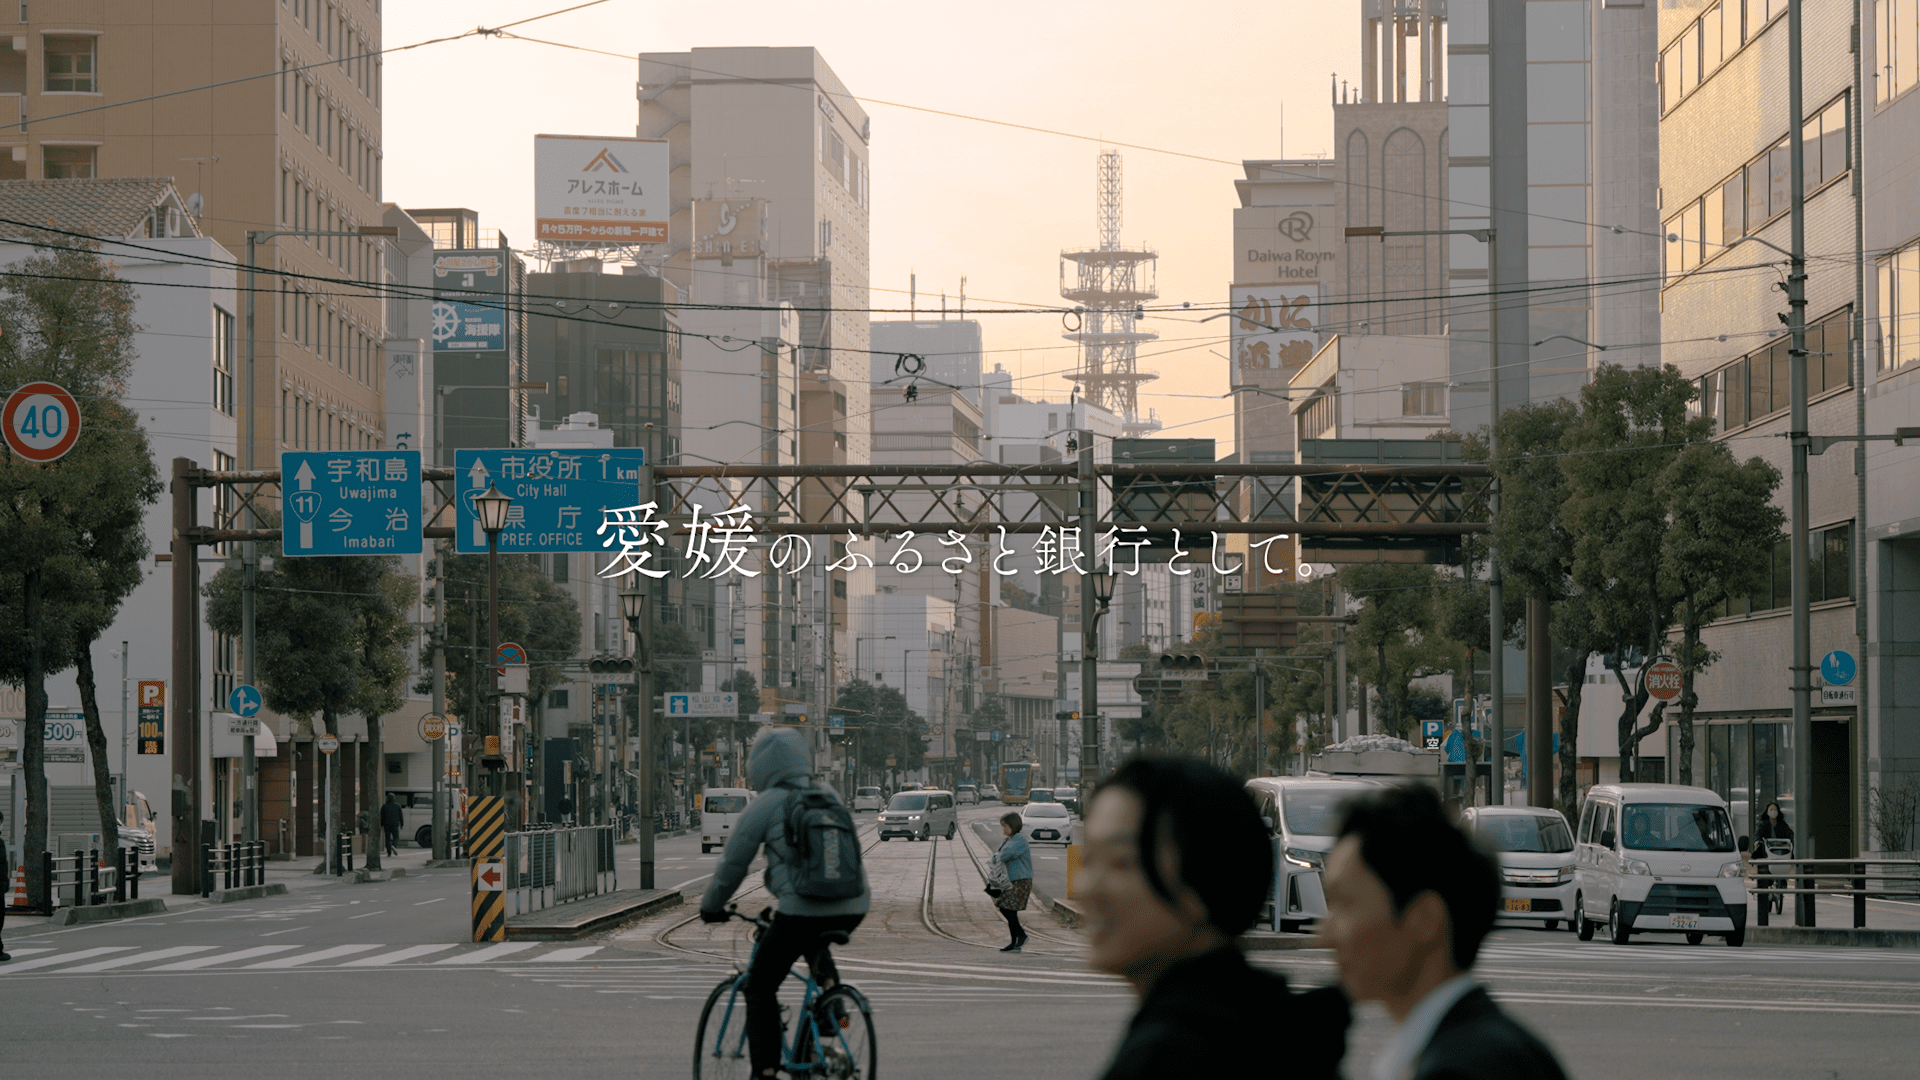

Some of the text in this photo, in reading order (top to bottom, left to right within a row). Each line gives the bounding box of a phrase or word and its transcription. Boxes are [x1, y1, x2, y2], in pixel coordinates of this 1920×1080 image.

[568, 179, 643, 195] アレスホーム
[1248, 250, 1291, 262] Daiwa
[1278, 266, 1318, 278] Hotel
[465, 323, 501, 336] 海援隊
[21, 405, 62, 438] 40
[327, 457, 408, 482] 宇和島
[500, 456, 582, 480] 市役所
[616, 467, 637, 480] km
[339, 486, 397, 501] Uwajima
[517, 484, 567, 499] City Hall
[296, 496, 313, 513] 11
[328, 507, 409, 532] 今治
[343, 535, 395, 548] Imabari
[502, 533, 583, 547] PREF. OFFICE
[1649, 674, 1680, 689] 消火栓
[144, 686, 159, 704] P
[1823, 690, 1854, 700] 自転車通行可
[44, 722, 74, 740] 500
[139, 722, 158, 738] 100
[1427, 722, 1439, 736] P
[1426, 738, 1440, 750] 空
